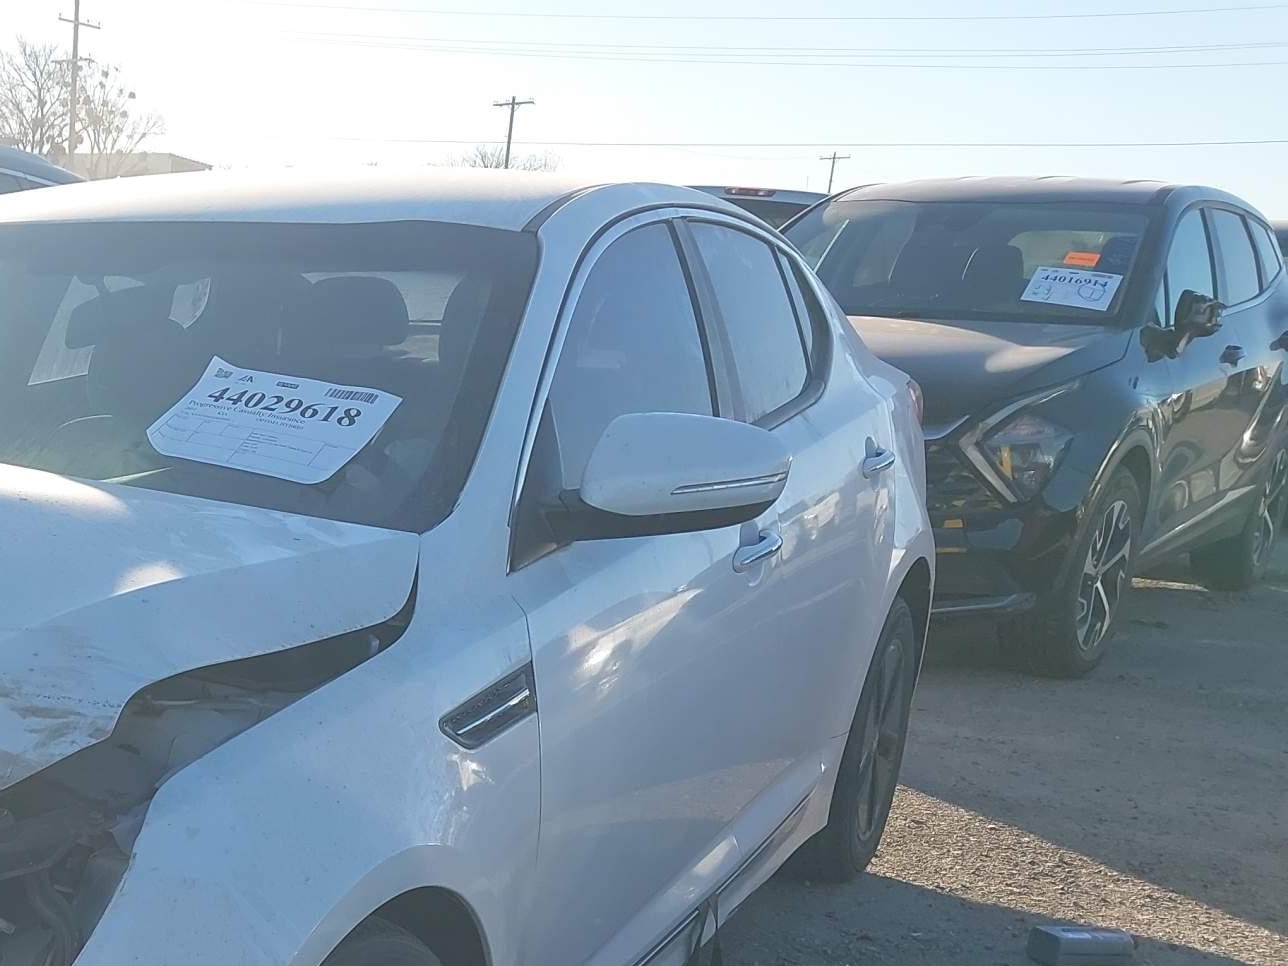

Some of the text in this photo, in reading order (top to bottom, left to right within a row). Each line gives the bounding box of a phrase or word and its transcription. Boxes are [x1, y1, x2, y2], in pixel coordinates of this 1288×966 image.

[208, 387, 362, 427] 44029618
[233, 405, 265, 418] Casualty
[268, 412, 306, 425] Insurance
